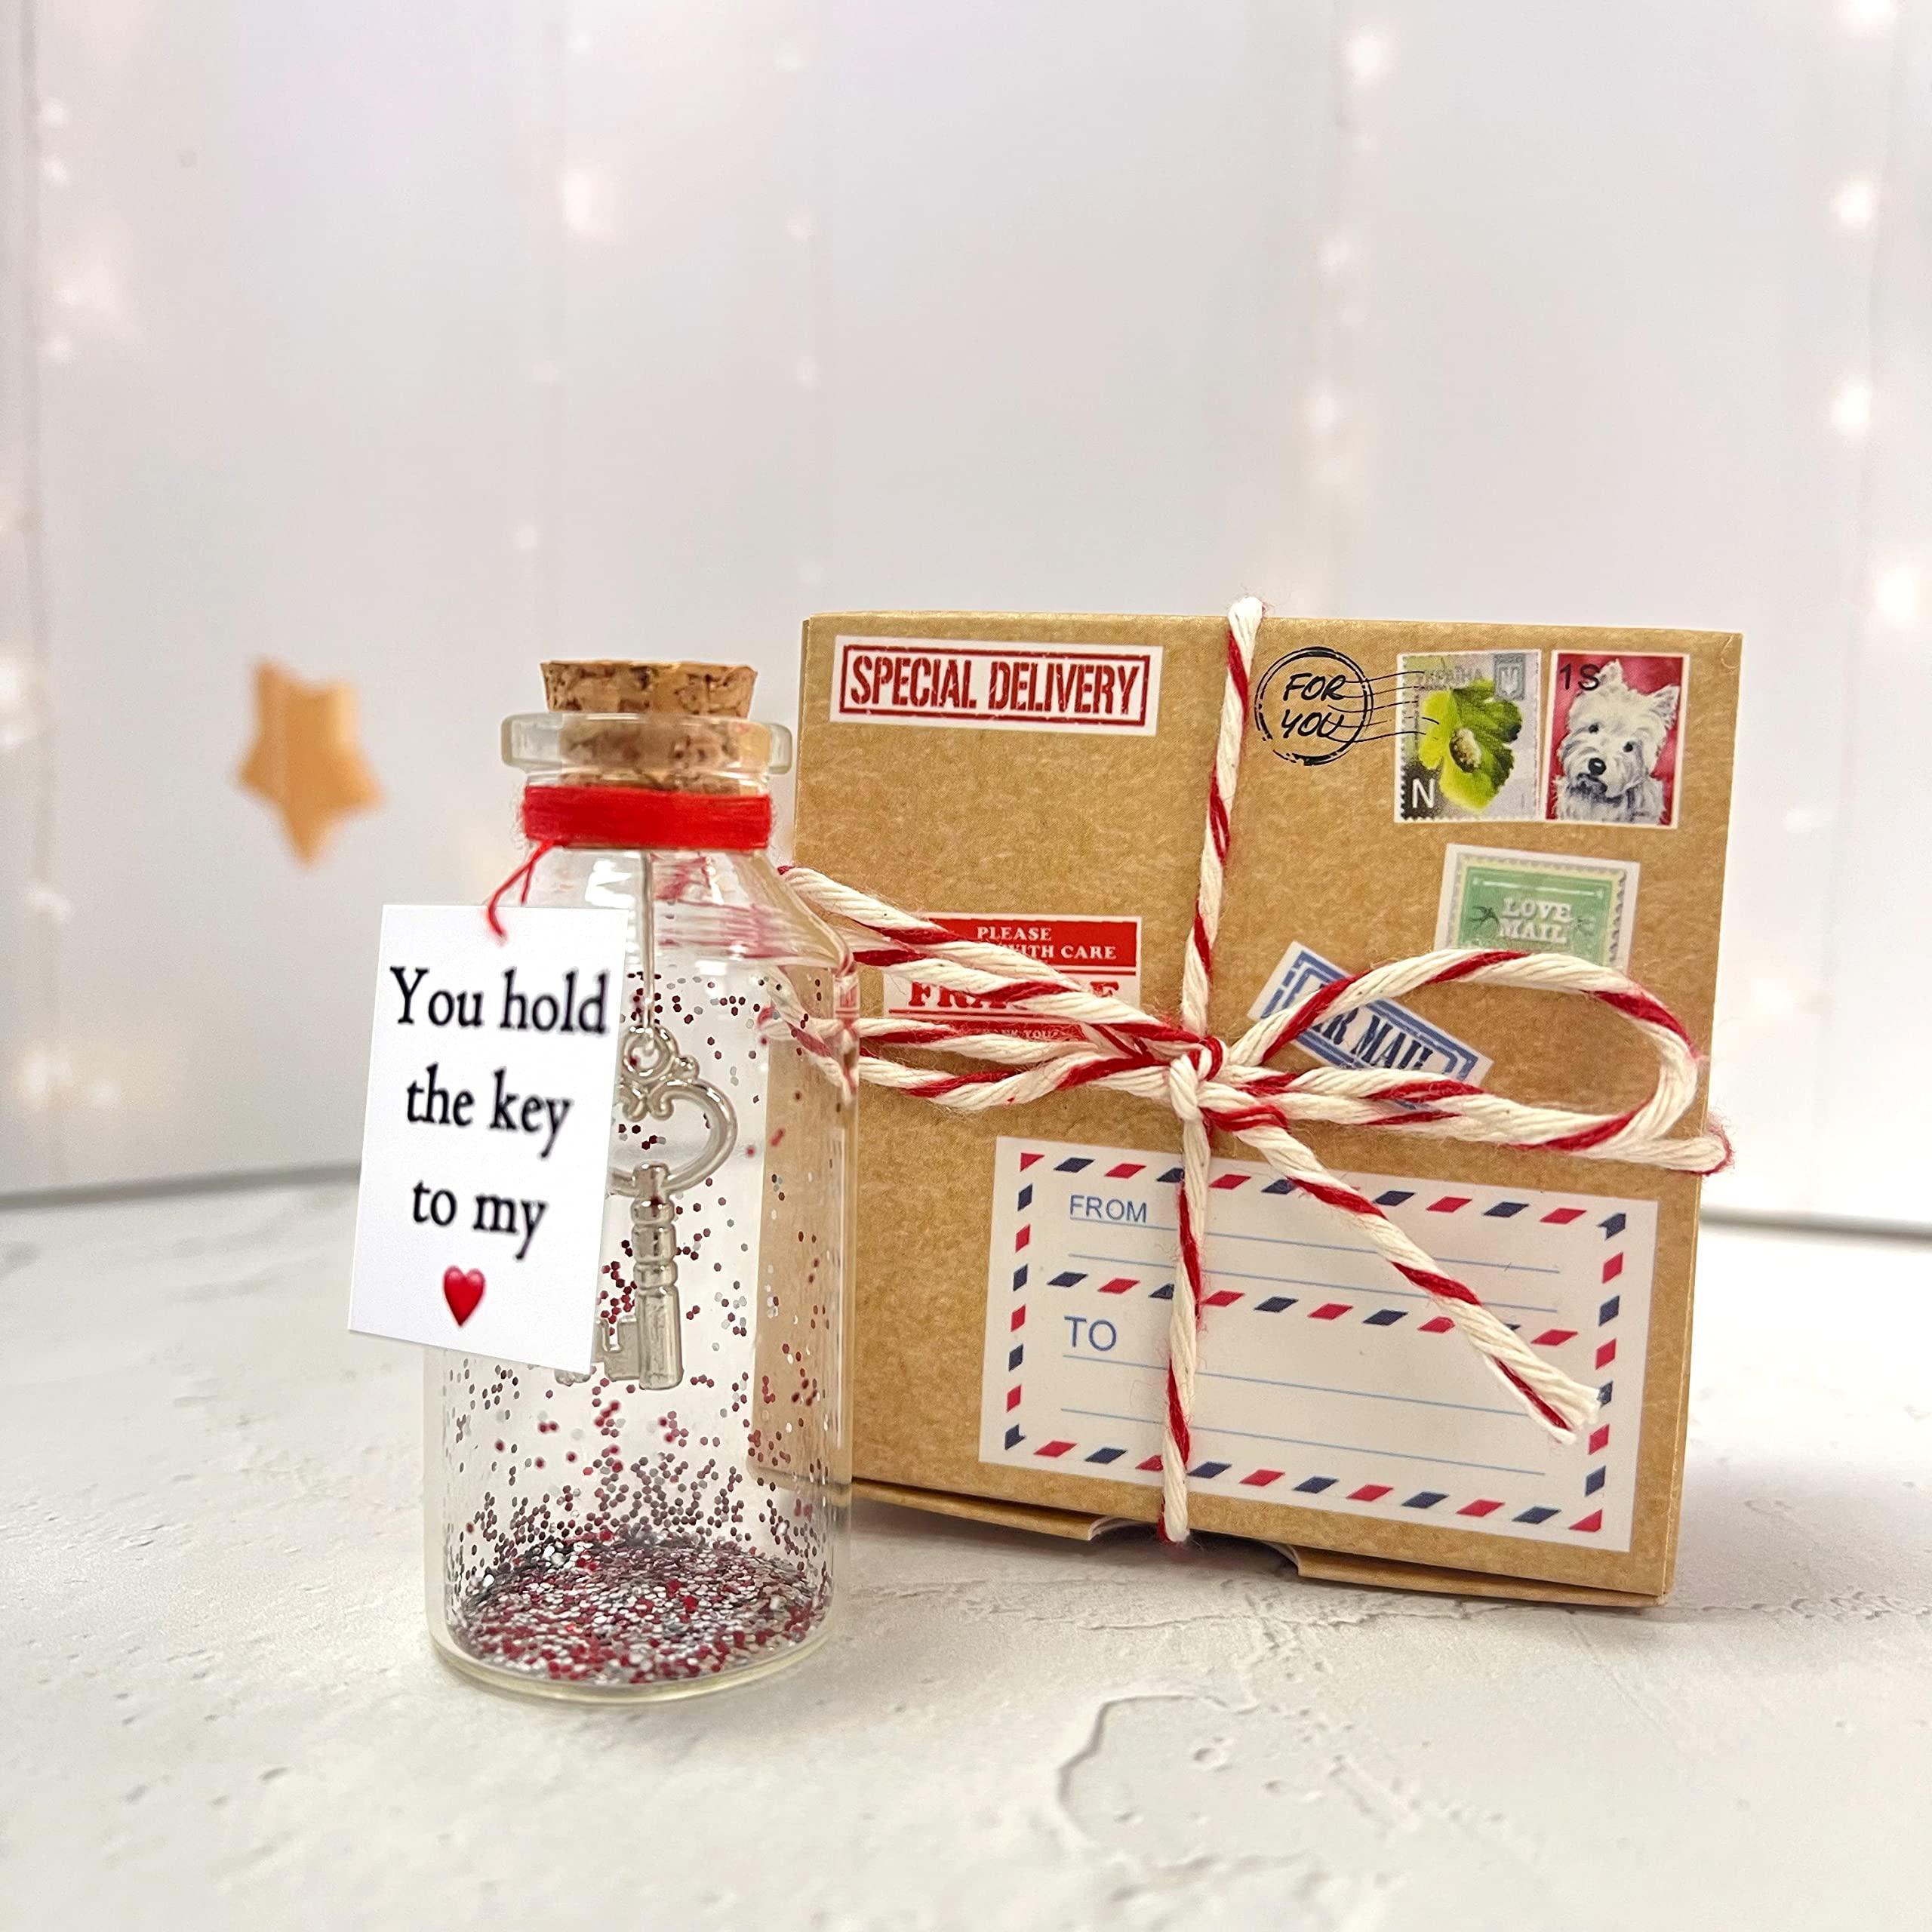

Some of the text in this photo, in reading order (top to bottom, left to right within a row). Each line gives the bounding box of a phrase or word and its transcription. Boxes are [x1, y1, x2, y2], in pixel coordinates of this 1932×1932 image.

[851, 654, 1142, 715] SPECIAL DELIVERY
[1283, 672, 1346, 701] FOR
[1281, 709, 1345, 739] YOU
[1412, 777, 1435, 808] N
[1502, 897, 1573, 923] LOVE
[977, 926, 1053, 941] PLEASE
[1499, 918, 1567, 944] MAIL
[1060, 944, 1117, 960] CARE
[390, 965, 610, 1036] You hold
[406, 1062, 574, 1158] the key
[412, 1180, 549, 1262] to my
[1070, 1194, 1147, 1223] FROM
[1064, 1315, 1117, 1352] TO
